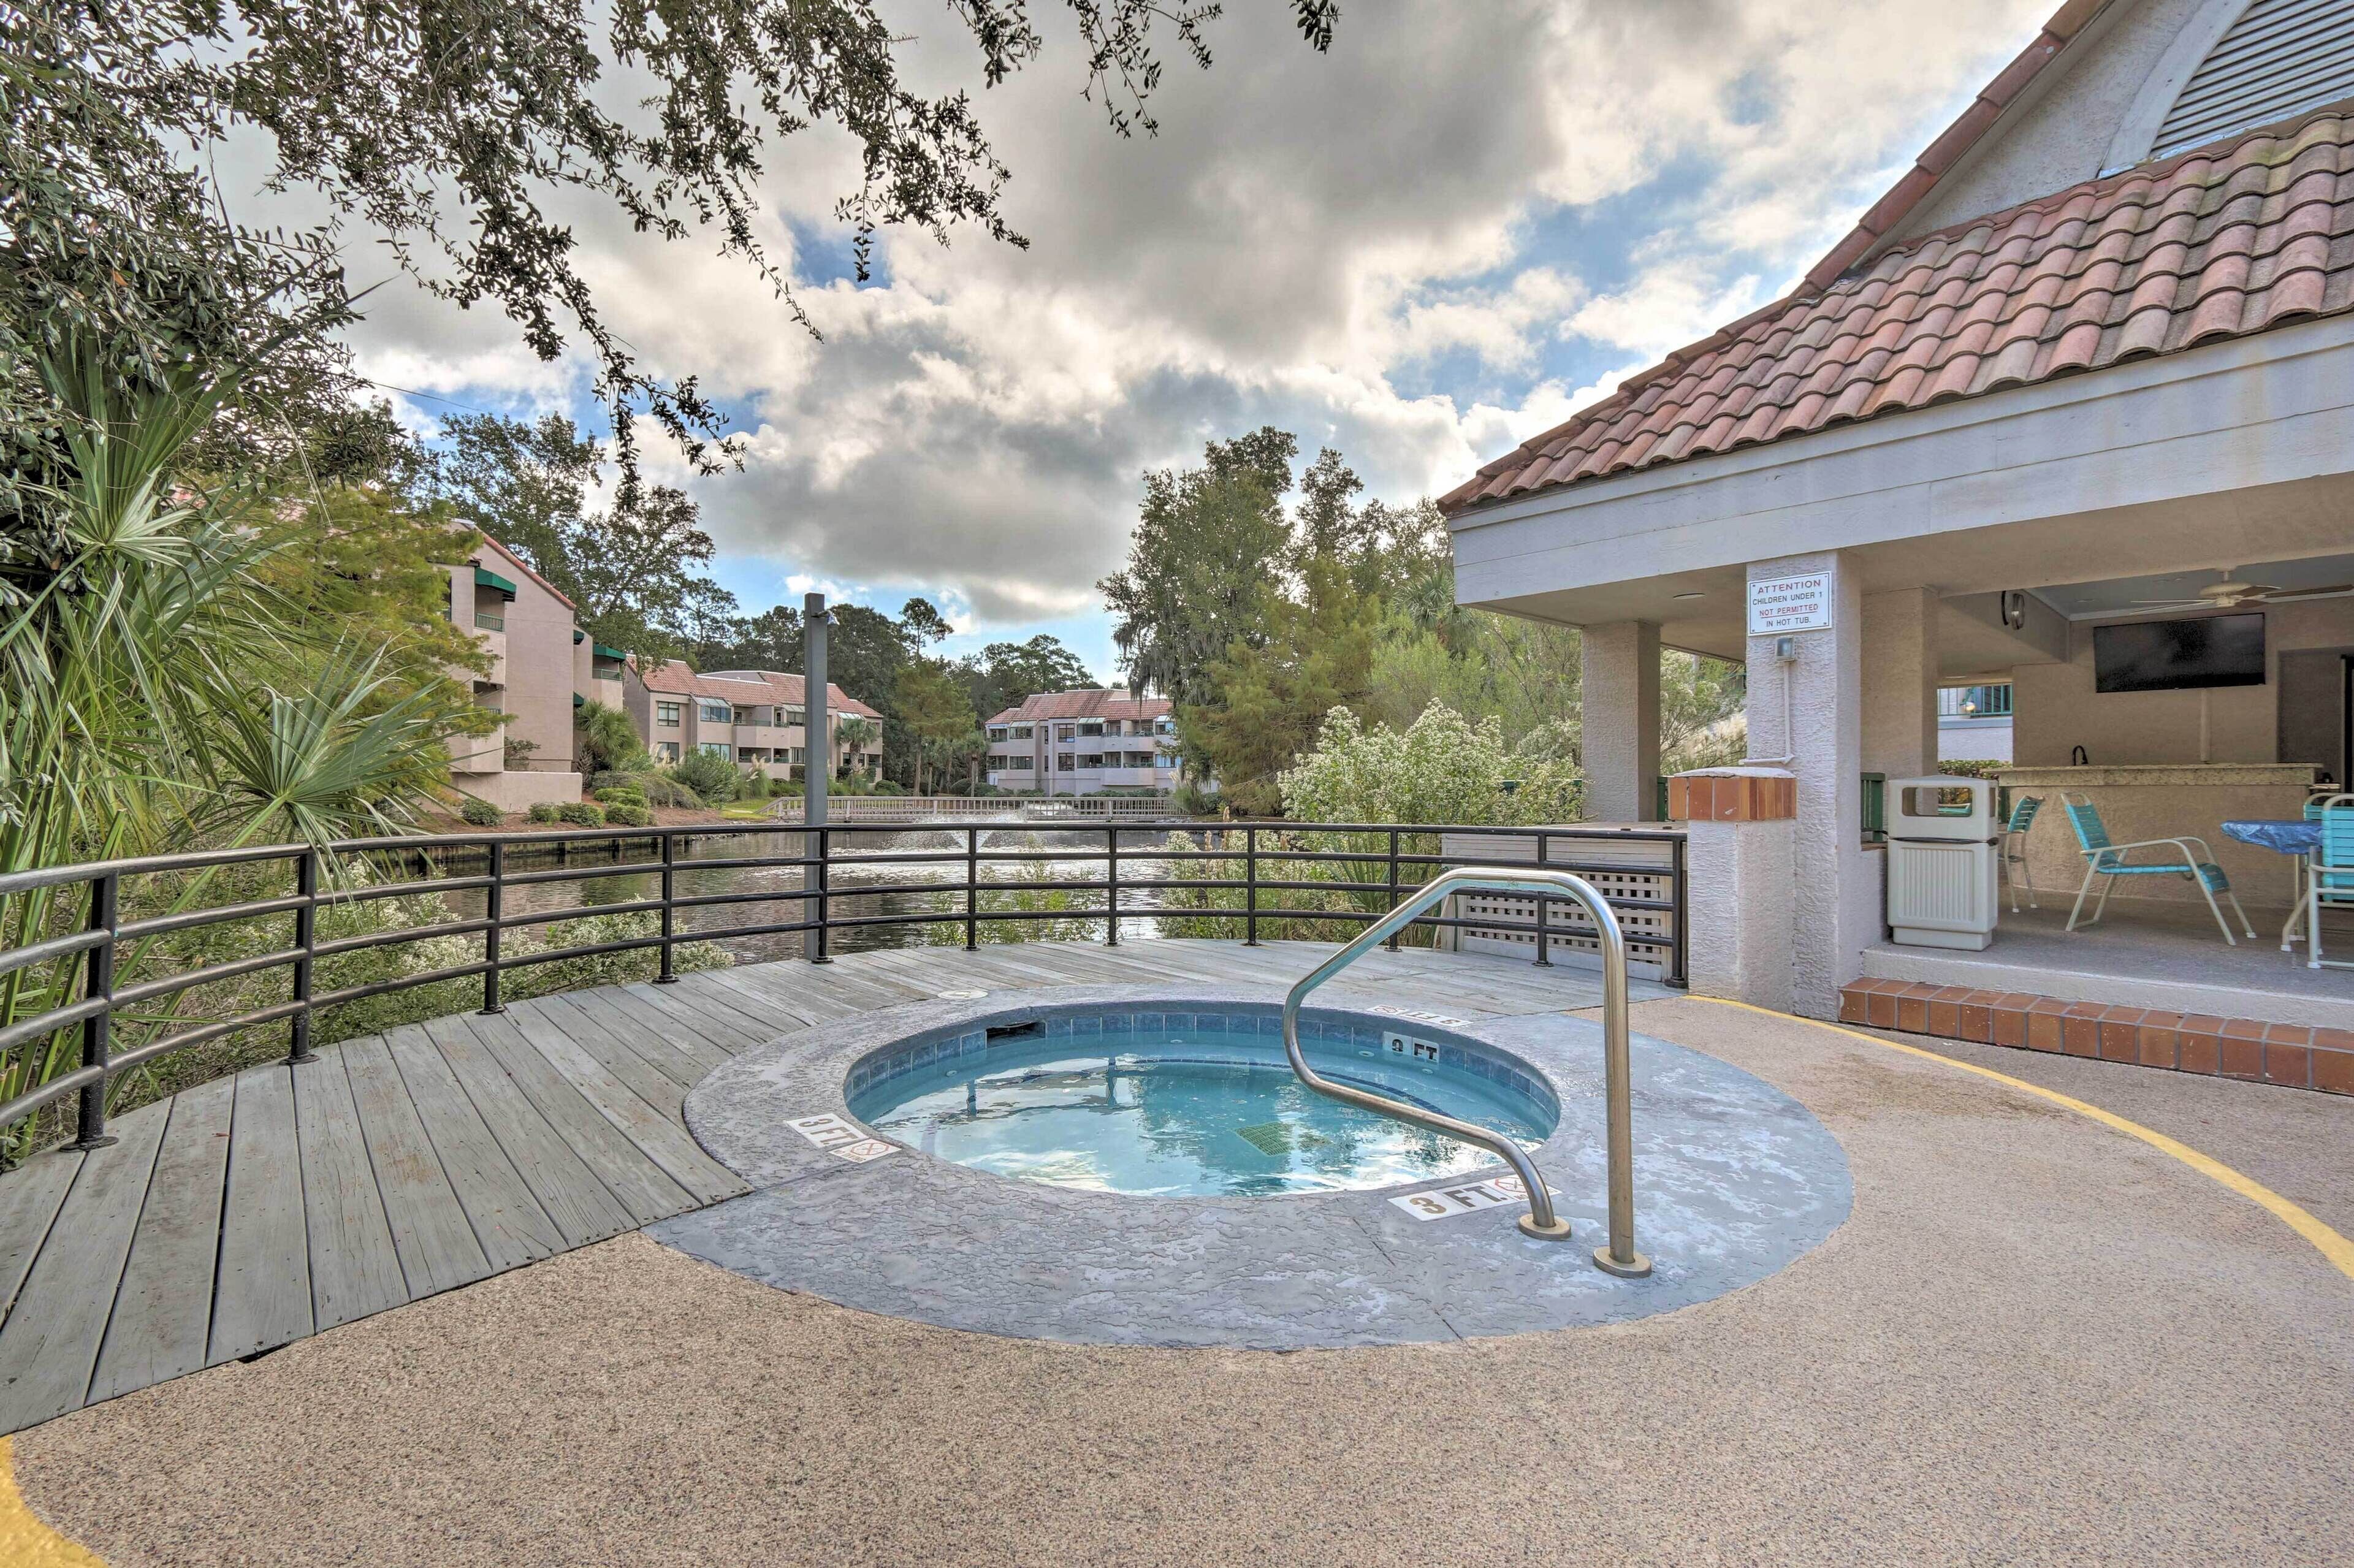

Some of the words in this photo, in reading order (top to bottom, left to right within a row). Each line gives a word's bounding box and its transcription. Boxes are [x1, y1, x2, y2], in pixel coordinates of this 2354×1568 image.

[1758, 579, 1821, 594] ATTENTION
[1753, 595, 1787, 606] CHILDREN
[1791, 592, 1815, 601] UNDER
[1778, 603, 1818, 615] PERMITTED
[1777, 618, 1791, 626] HOT
[798, 1117, 834, 1127] 3
[1409, 1197, 1447, 1214] 3
[1443, 1185, 1508, 1208] FT.
